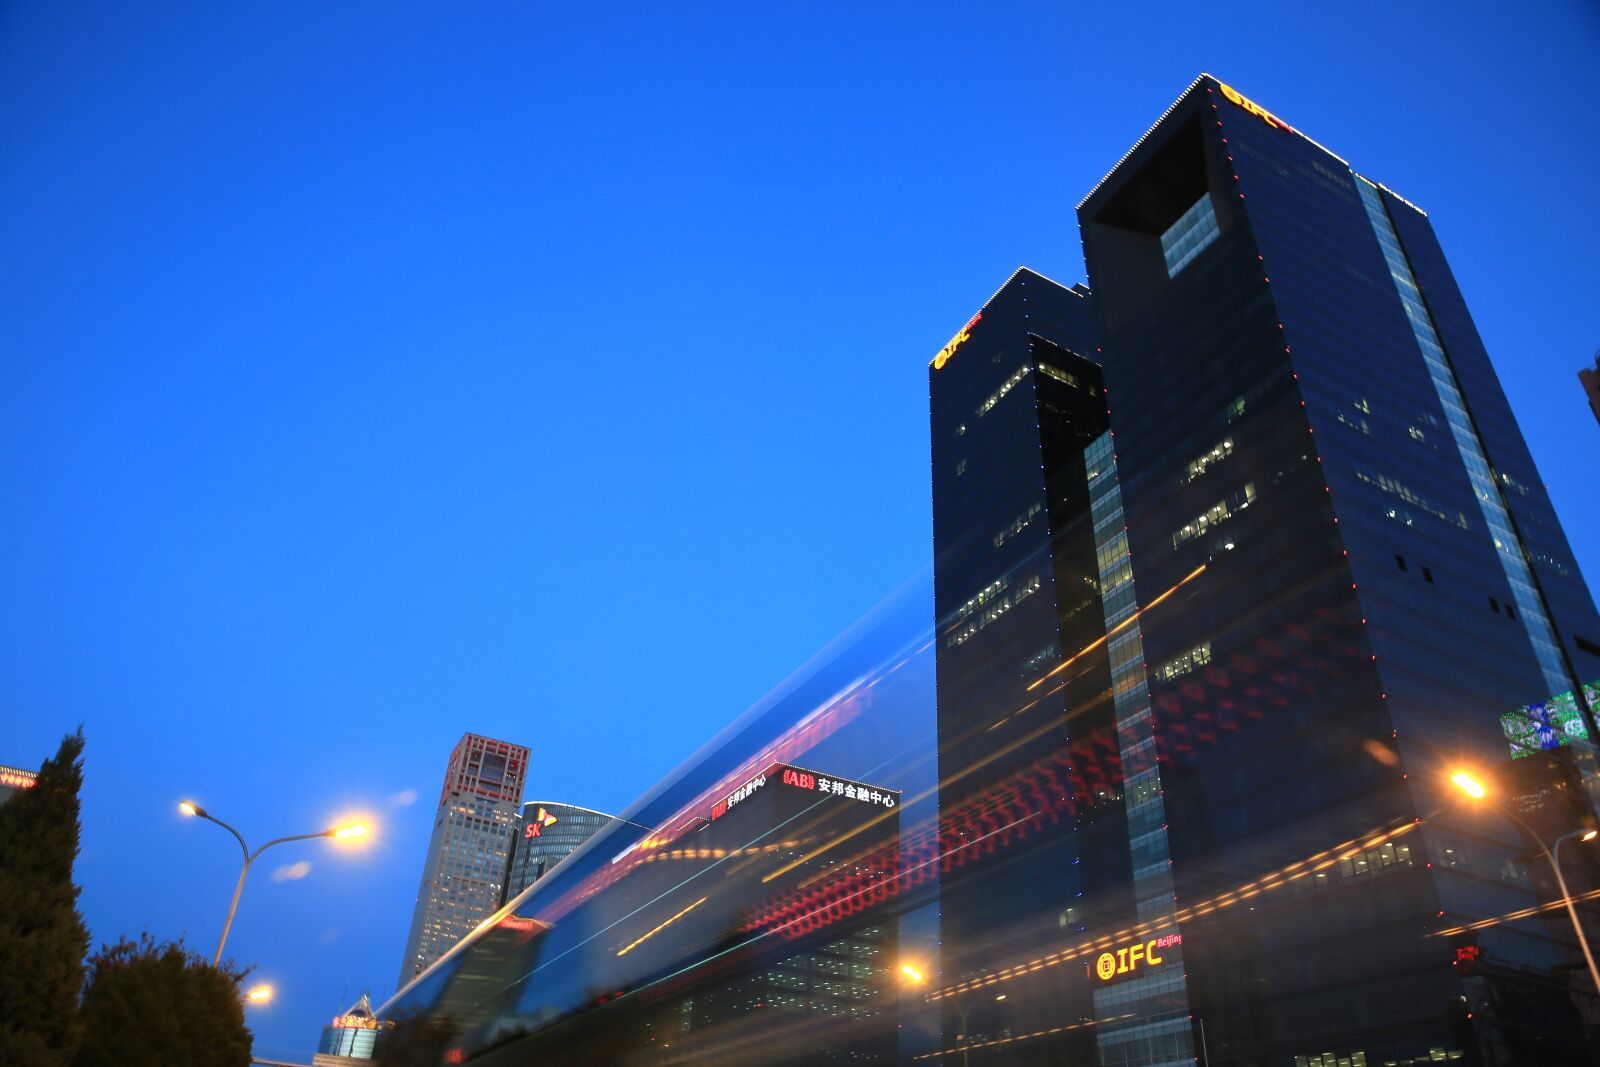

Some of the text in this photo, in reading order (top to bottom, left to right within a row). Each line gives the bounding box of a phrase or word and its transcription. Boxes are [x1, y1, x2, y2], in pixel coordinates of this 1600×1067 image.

[818, 778, 895, 808] 安邦金融中心
[524, 823, 542, 839] SK
[1116, 934, 1182, 974] IFC Beijing
